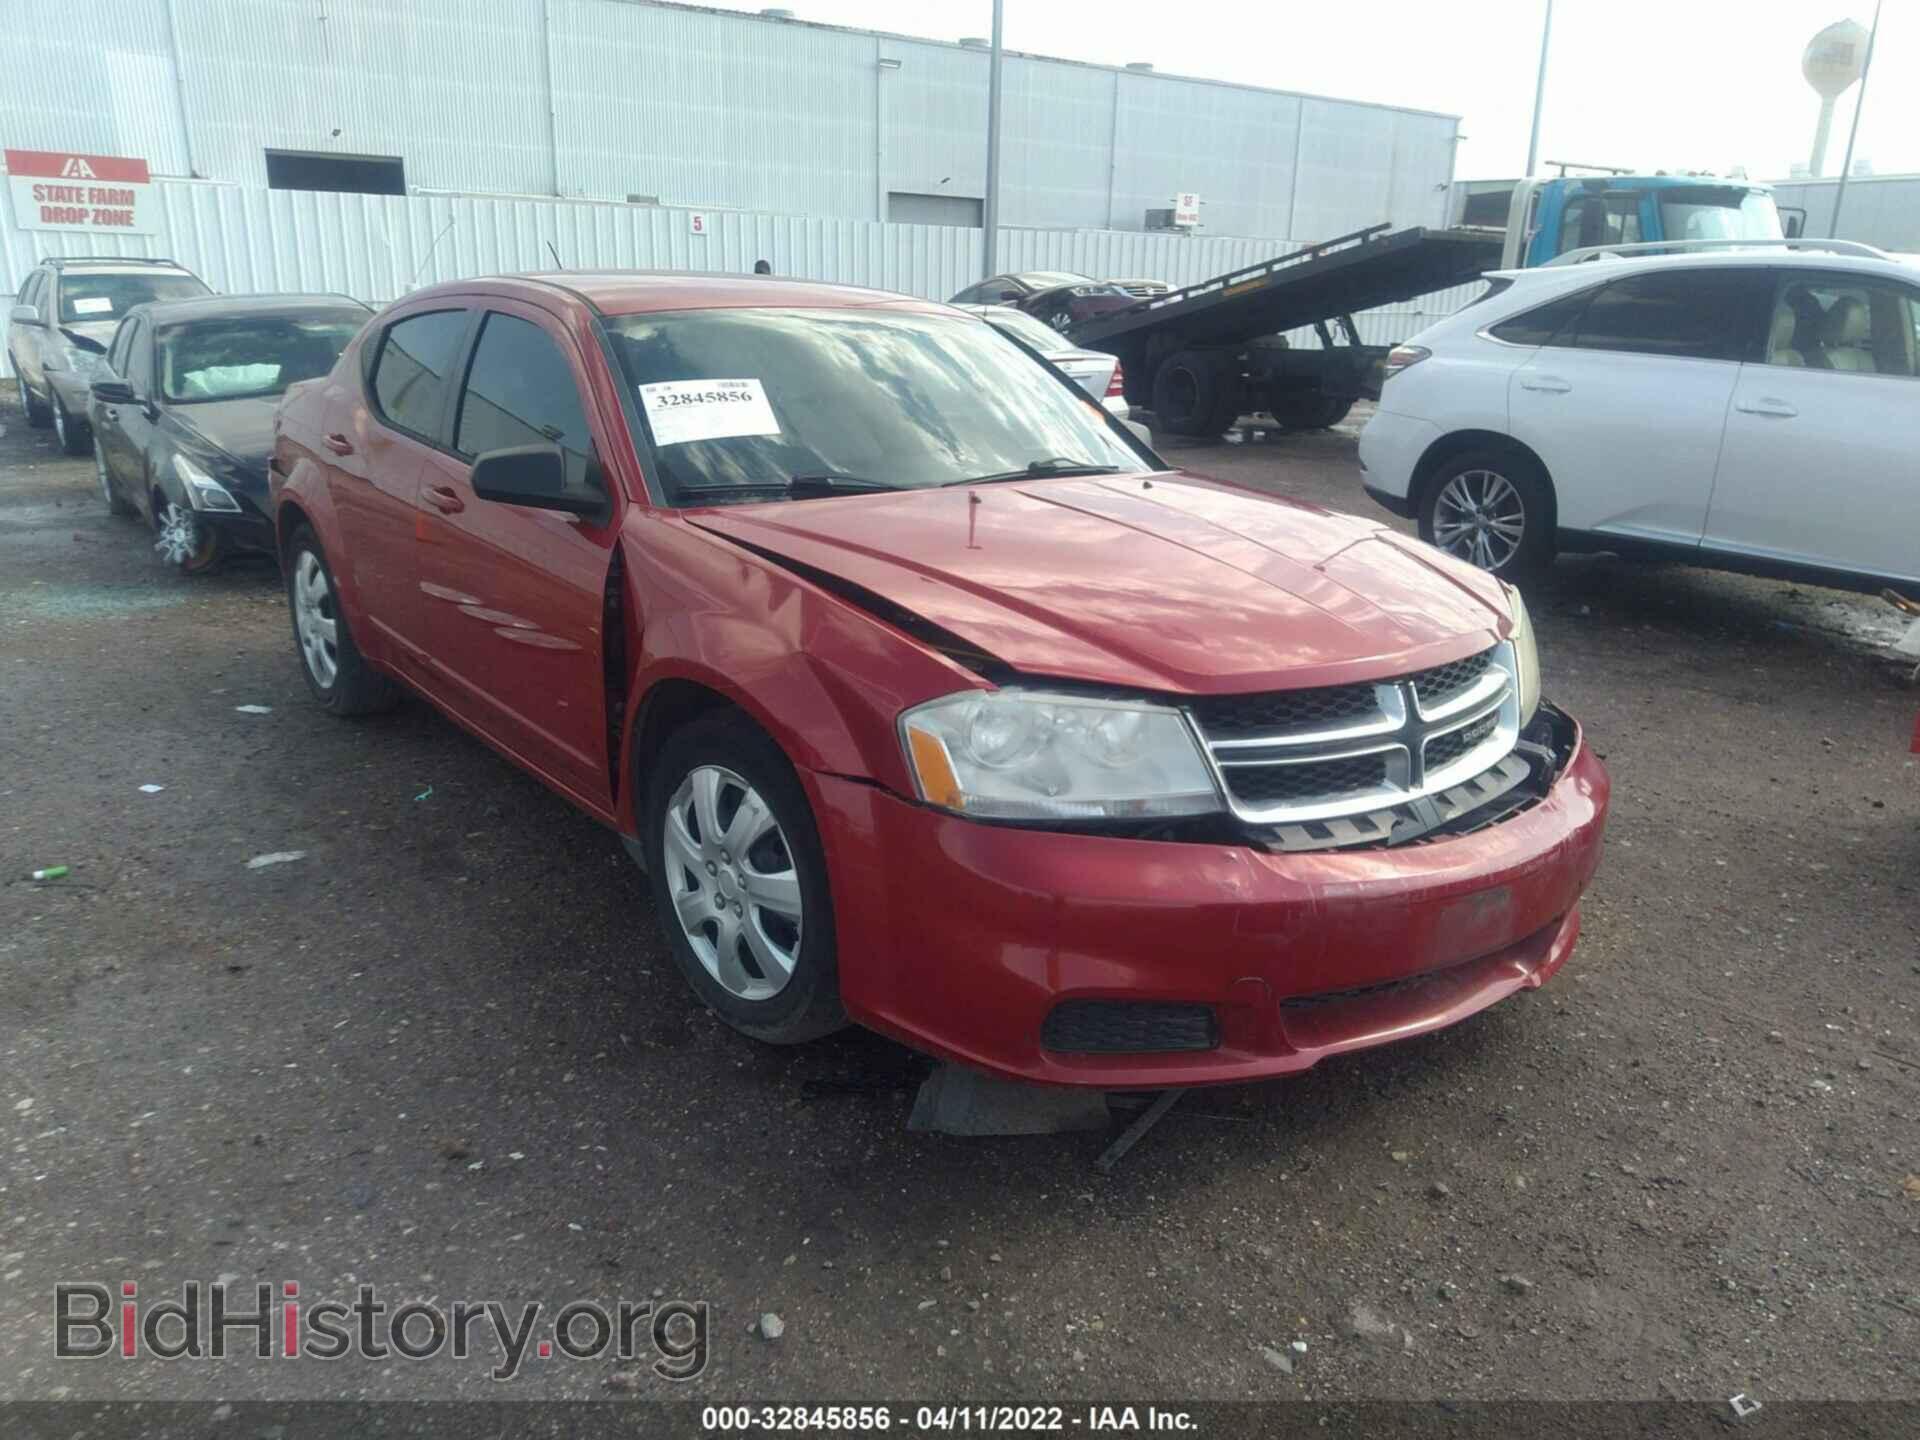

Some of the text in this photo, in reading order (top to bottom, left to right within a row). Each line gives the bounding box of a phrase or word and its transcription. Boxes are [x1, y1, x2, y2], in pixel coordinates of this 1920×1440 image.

[33, 184, 135, 206] STATE FARM
[40, 205, 135, 226] DROP ZONE
[693, 215, 703, 232] 5
[657, 391, 753, 407] 32845856
